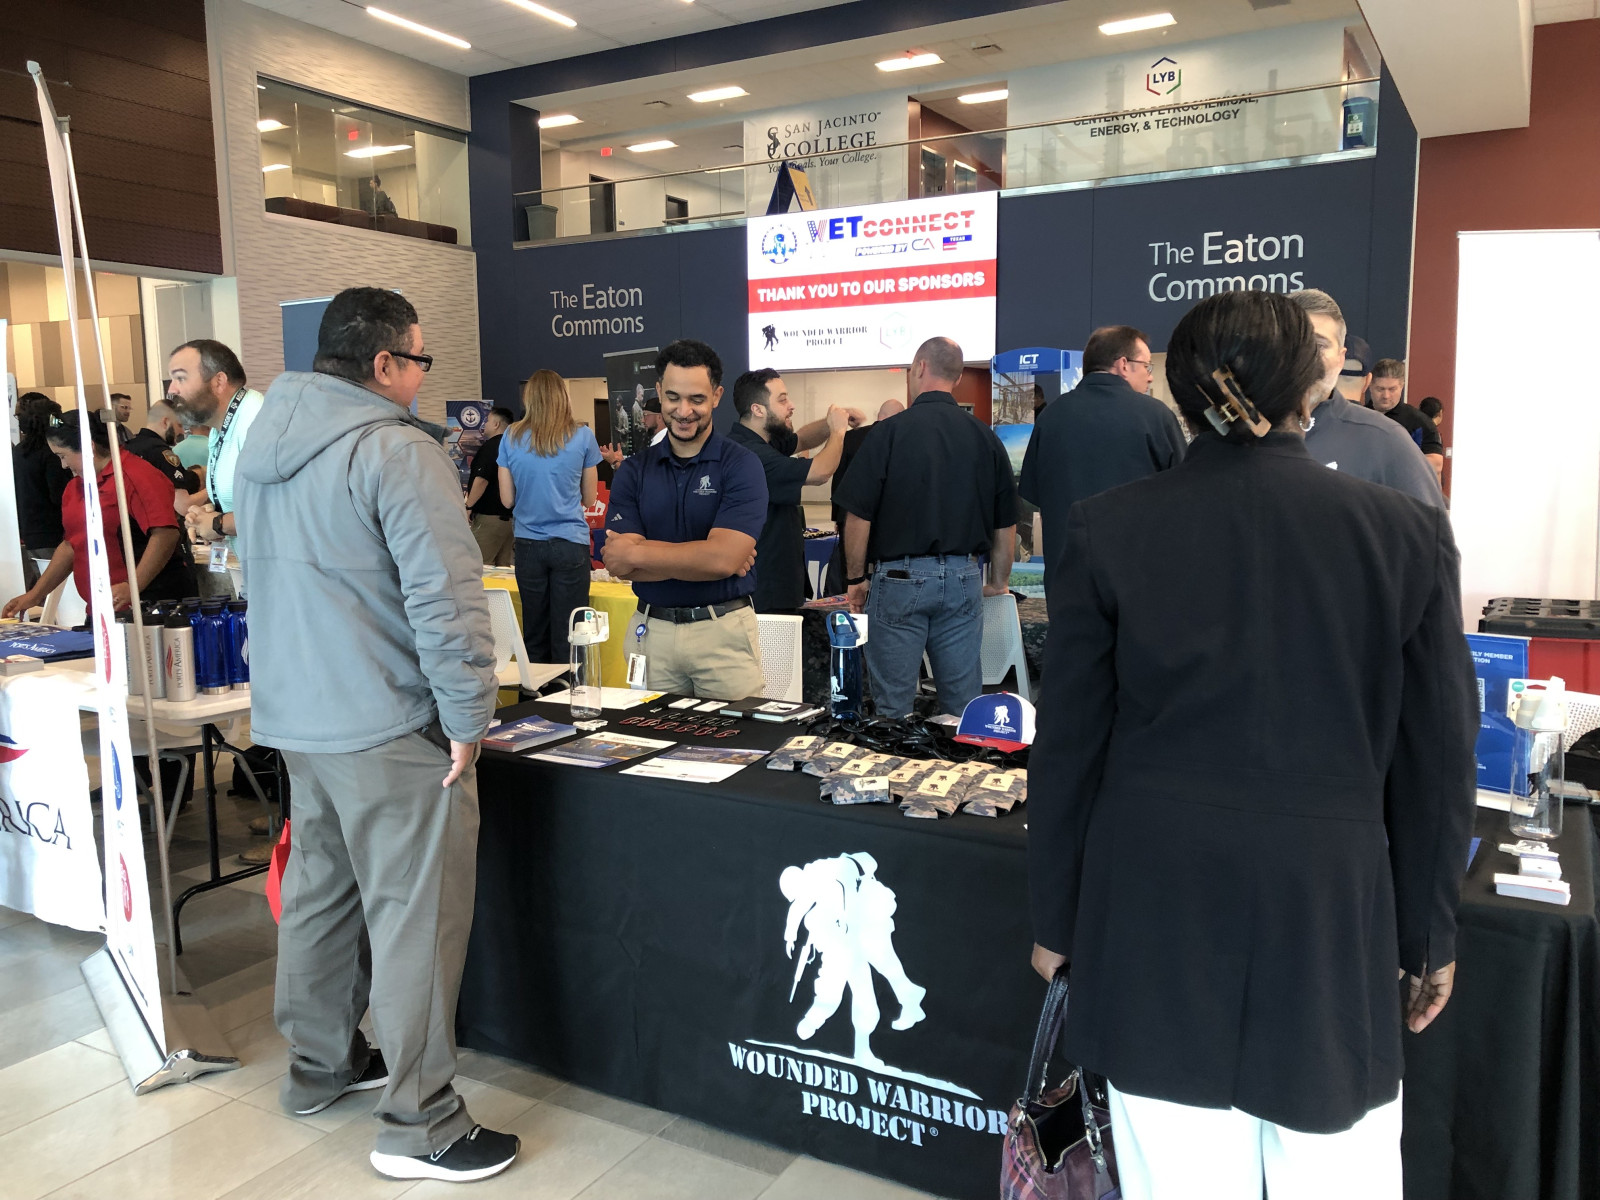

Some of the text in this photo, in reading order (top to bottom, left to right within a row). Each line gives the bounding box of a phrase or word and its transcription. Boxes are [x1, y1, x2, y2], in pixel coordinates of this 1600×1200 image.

[1153, 71, 1176, 84] LYB
[784, 121, 812, 139] SAN
[1090, 108, 1241, 138] ENERGY, & TECHNOLOGY
[783, 130, 878, 158] COLLEGE
[819, 157, 840, 167] Your
[842, 152, 878, 164] College.
[1148, 230, 1304, 266] The Eaton
[549, 283, 643, 310] The Eaton
[757, 271, 986, 303] THANK YOU TO OUR SPONSORS
[1148, 271, 1305, 303] Commons
[551, 314, 645, 338] Commons
[827, 325, 868, 335] WARRIOR
[1019, 353, 1040, 365] ICT
[1483, 652, 1514, 661] MEMBER
[0, 797, 73, 851] RICA
[728, 1041, 1009, 1136] WOUNDED WARRIOR
